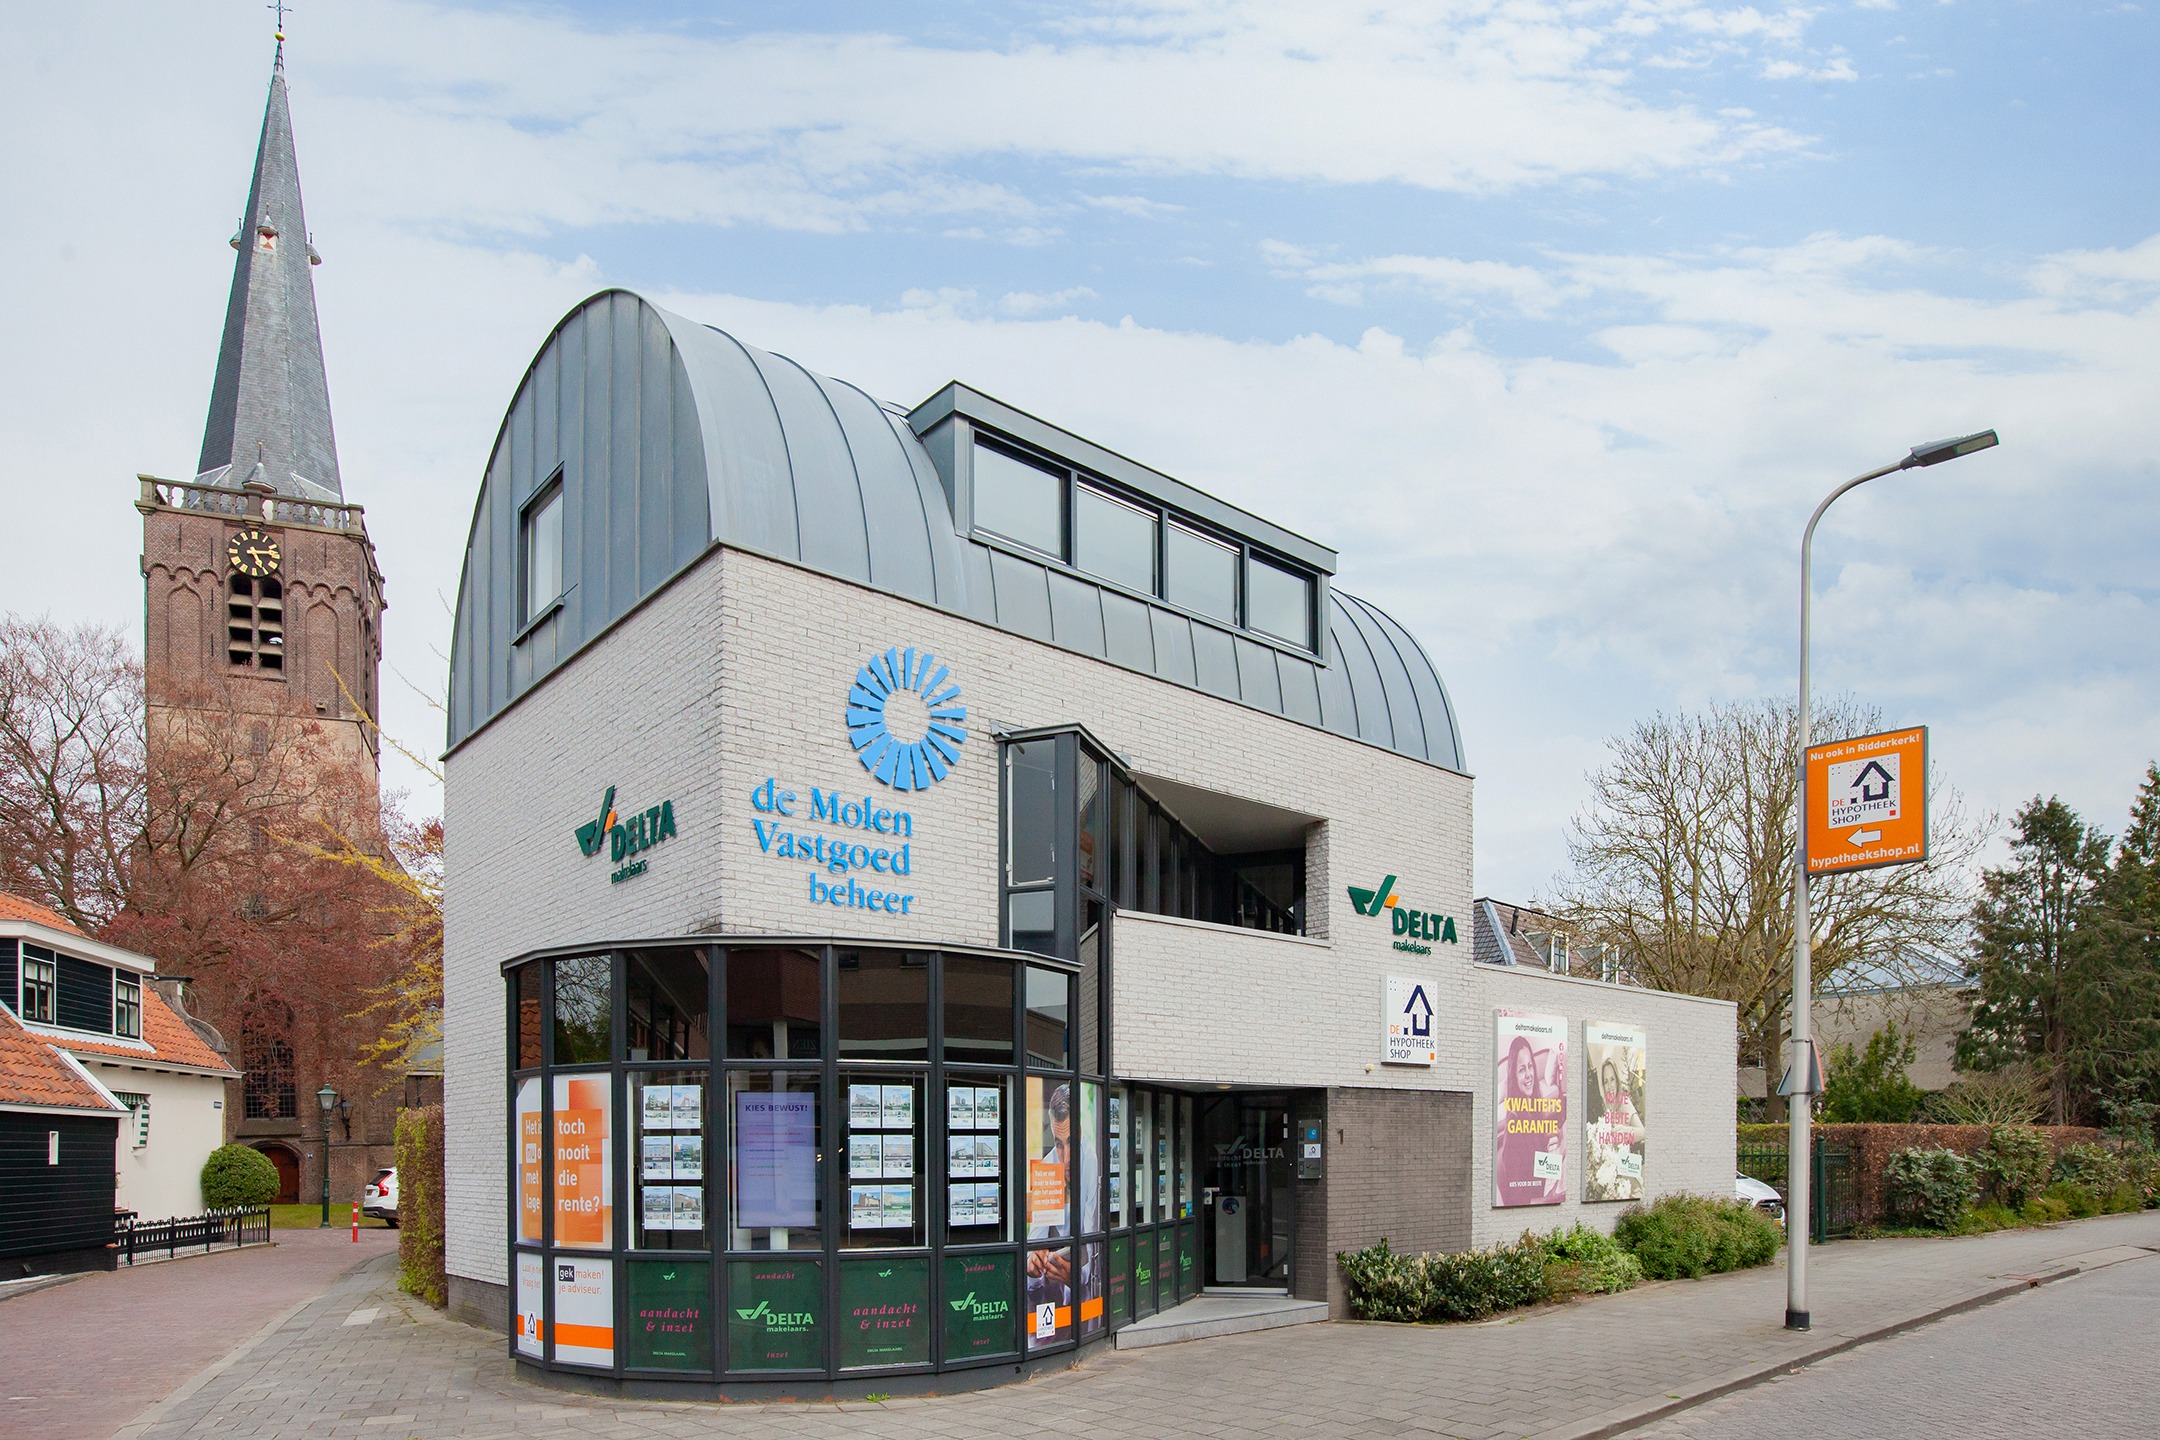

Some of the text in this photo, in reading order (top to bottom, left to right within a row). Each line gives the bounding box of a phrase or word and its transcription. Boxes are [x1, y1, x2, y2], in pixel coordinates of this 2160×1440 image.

[1810, 753, 1823, 761] Nu
[1826, 748, 1843, 757] ook
[1858, 734, 1920, 752] Ridderkerk!
[752, 778, 914, 836] de Molen
[1832, 798, 1845, 807] DE
[1832, 800, 1896, 816] HYPOTHEEK
[1832, 814, 1861, 825] SHOP
[611, 800, 676, 862] DELTA
[752, 818, 910, 875] Vastgoed
[1811, 843, 1920, 868] hypotheekshop.nl
[611, 859, 647, 884] makelaars
[810, 872, 914, 915] beheer
[1392, 907, 1458, 944] DELTA
[1393, 939, 1431, 956] makelaars
[1390, 1024, 1400, 1034] DE
[1515, 1024, 1552, 1033] deltamakelaars.nl
[1390, 1037, 1435, 1049] HYPOTHEEK
[1601, 1033, 1633, 1042] deltamakelaars.nl
[1390, 1048, 1411, 1060] SHOP
[1605, 1092, 1629, 1105] IN DE
[745, 1104, 808, 1112] KIES BEWUST!
[1503, 1098, 1562, 1113] KWALITEITS
[1604, 1111, 1629, 1125] BESTE
[526, 1119, 537, 1135] Het
[558, 1118, 585, 1135] toch
[1507, 1119, 1558, 1134] GARANTIE
[1336, 1128, 1344, 1145] 1
[1599, 1132, 1635, 1146] HANDEN
[558, 1144, 590, 1160] nooit
[1243, 1148, 1285, 1159] DELTA
[1546, 1163, 1560, 1171] DELTA
[526, 1170, 578, 1186] met die
[526, 1193, 600, 1213] lage rente?
[560, 1268, 574, 1280] gek
[575, 1269, 605, 1280] maken!
[965, 1264, 995, 1272] aandacht
[558, 1285, 566, 1294] je
[567, 1284, 602, 1295] adviseur.
[640, 1308, 699, 1319] aandacht
[854, 1303, 917, 1316] aandacht
[973, 1301, 1009, 1314] DELTA
[766, 1313, 814, 1325] DELTA
[860, 1318, 911, 1330] & inzet
[646, 1322, 694, 1333] & inzet
